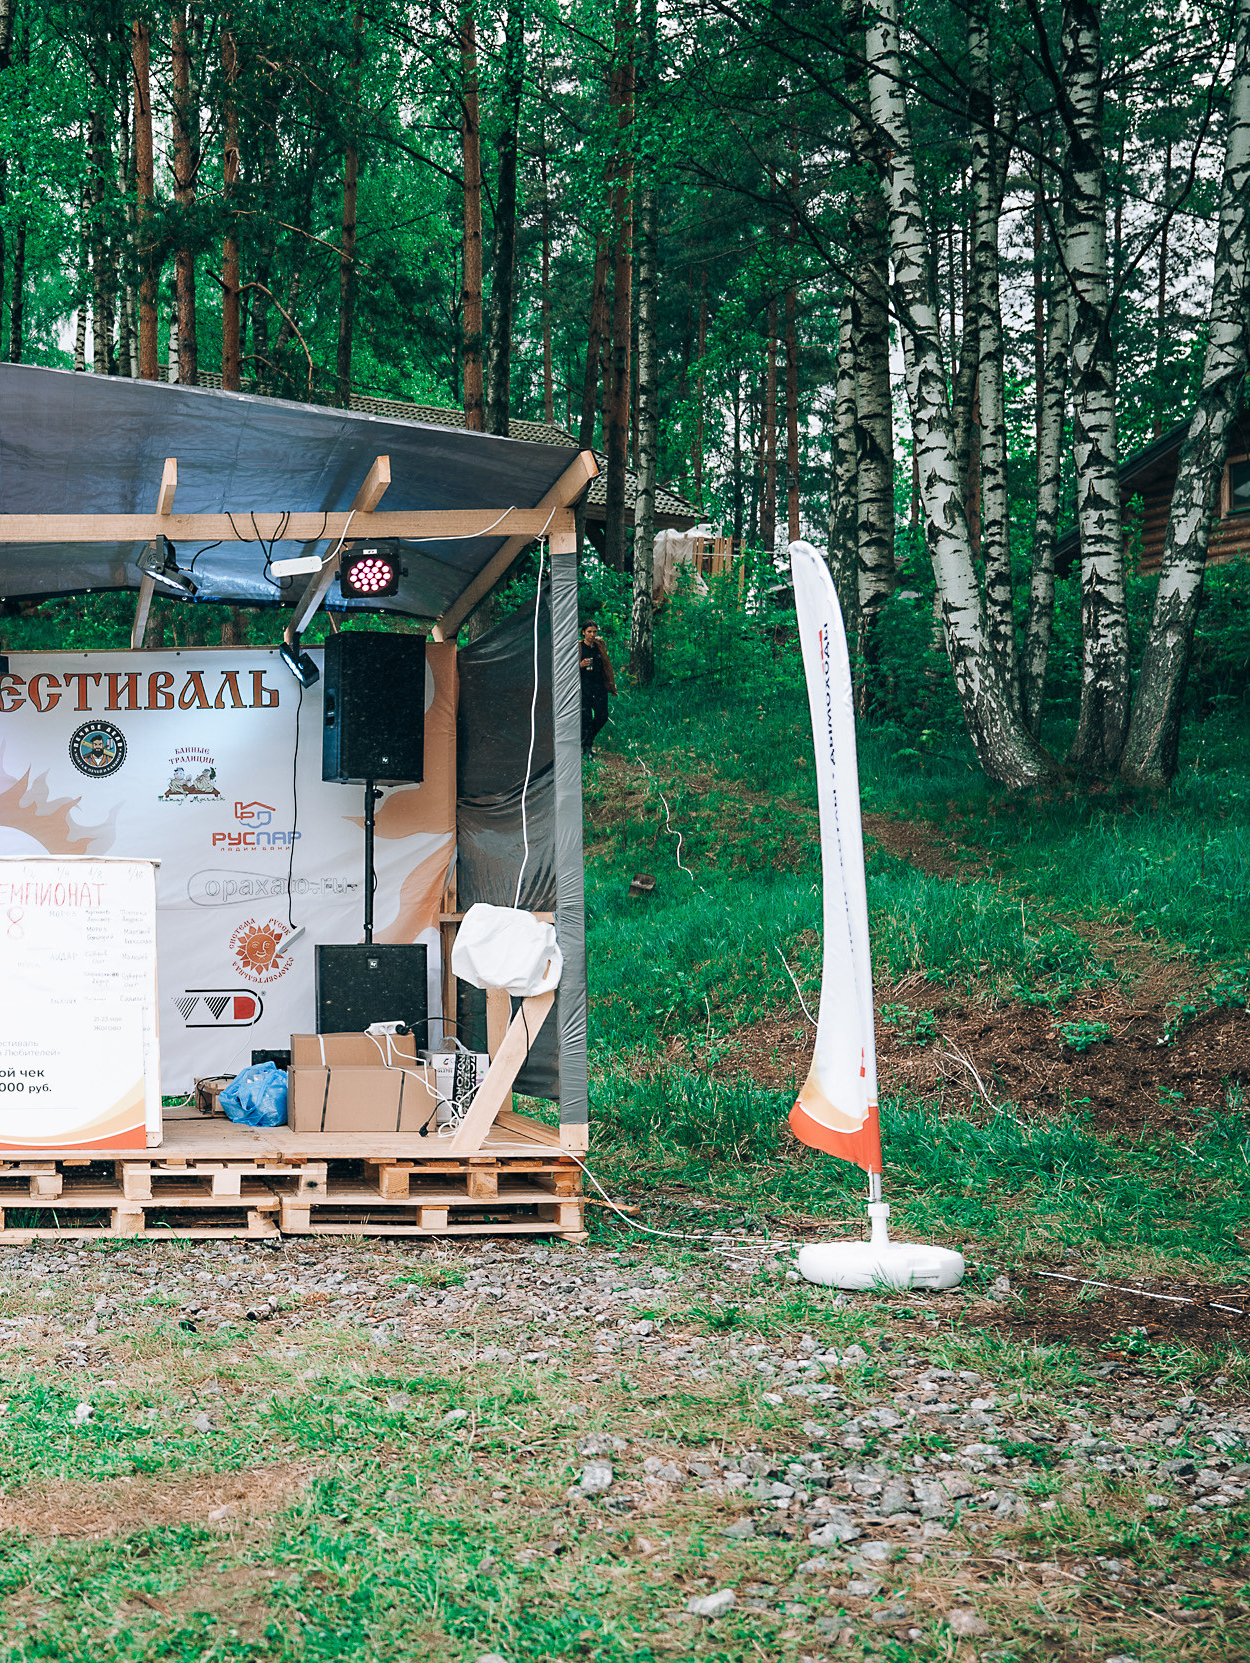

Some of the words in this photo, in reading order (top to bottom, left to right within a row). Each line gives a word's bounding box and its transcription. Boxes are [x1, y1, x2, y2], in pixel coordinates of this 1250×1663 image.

[212, 832, 302, 847] РУСПАР
[6, 906, 25, 940] 8
[20, 1069, 46, 1078] чек
[28, 1083, 53, 1095] руб.
